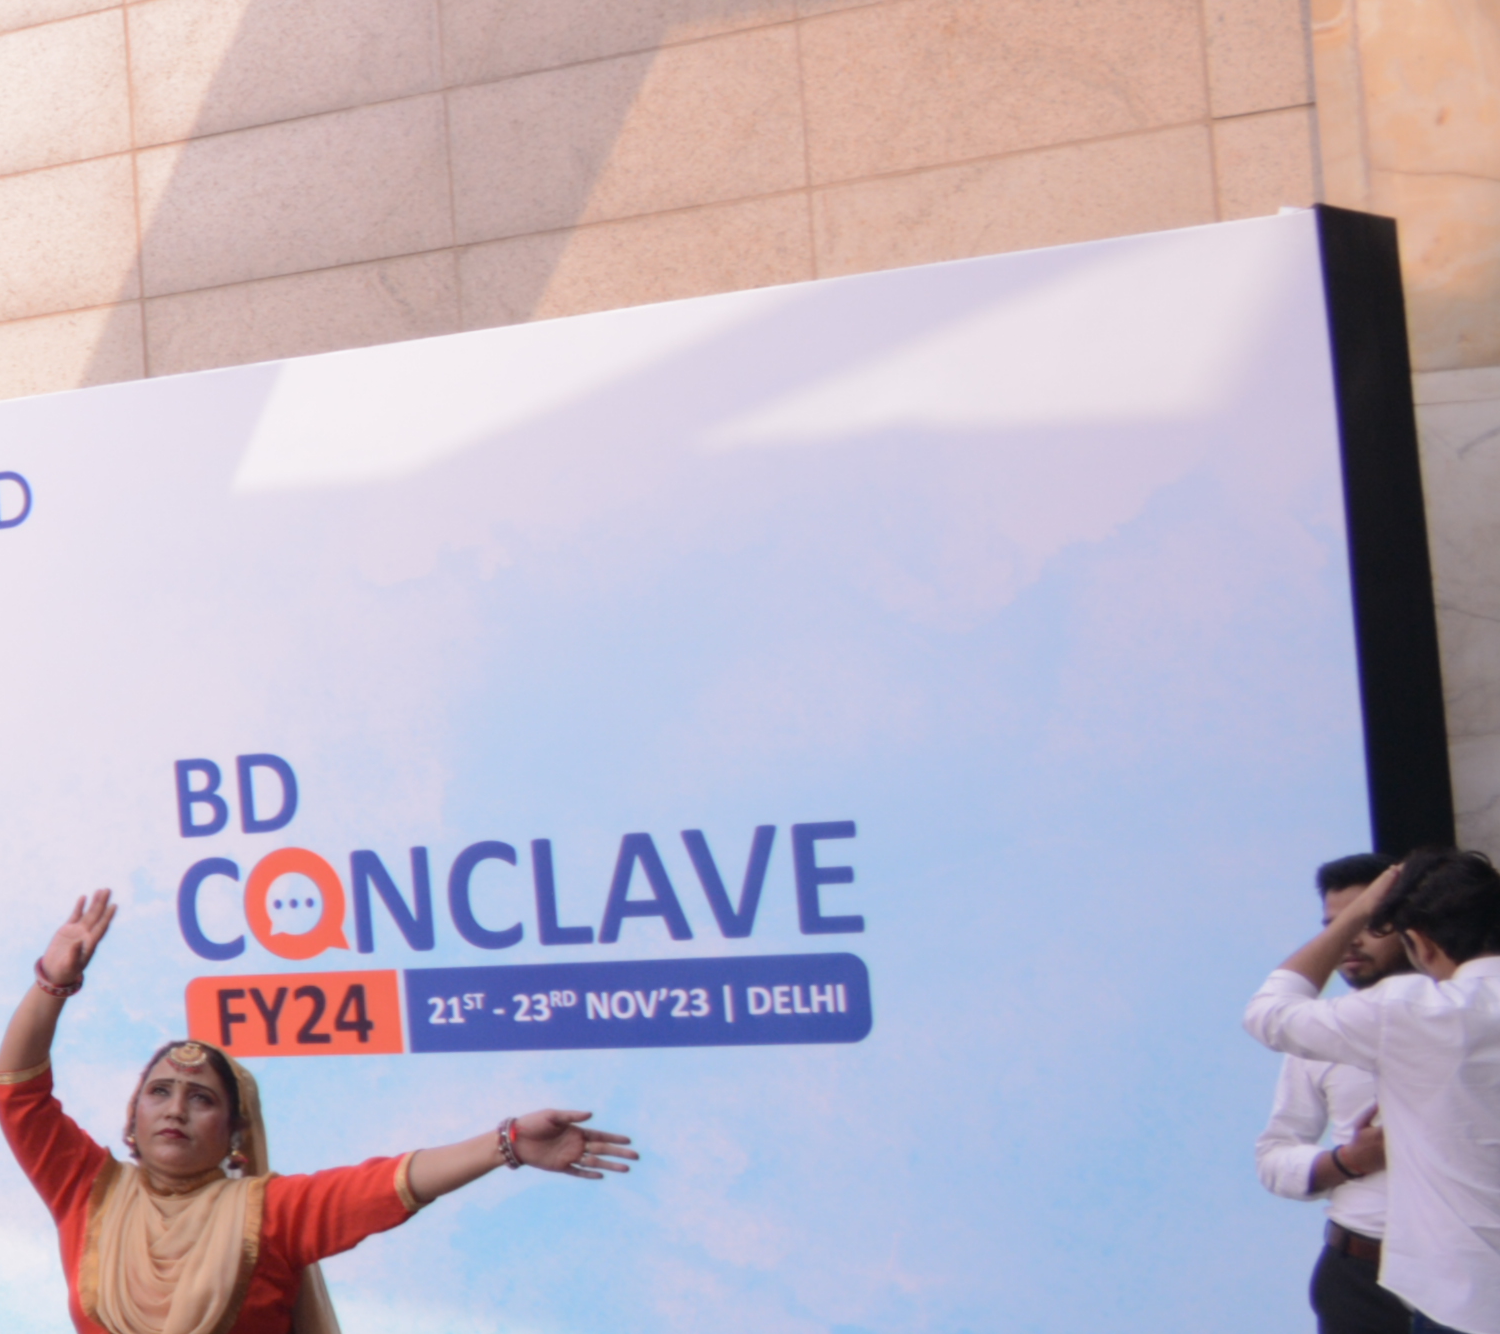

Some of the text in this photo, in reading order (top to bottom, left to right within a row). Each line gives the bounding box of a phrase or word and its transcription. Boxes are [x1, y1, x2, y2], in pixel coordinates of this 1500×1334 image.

[174, 753, 299, 839] BD
[176, 820, 865, 961] CONCLAVE
[217, 984, 374, 1047] FY24
[427, 993, 484, 1024] 21ST
[512, 990, 577, 1022] 23RD
[585, 988, 710, 1020] NOV'23
[747, 984, 846, 1015] DELHI
